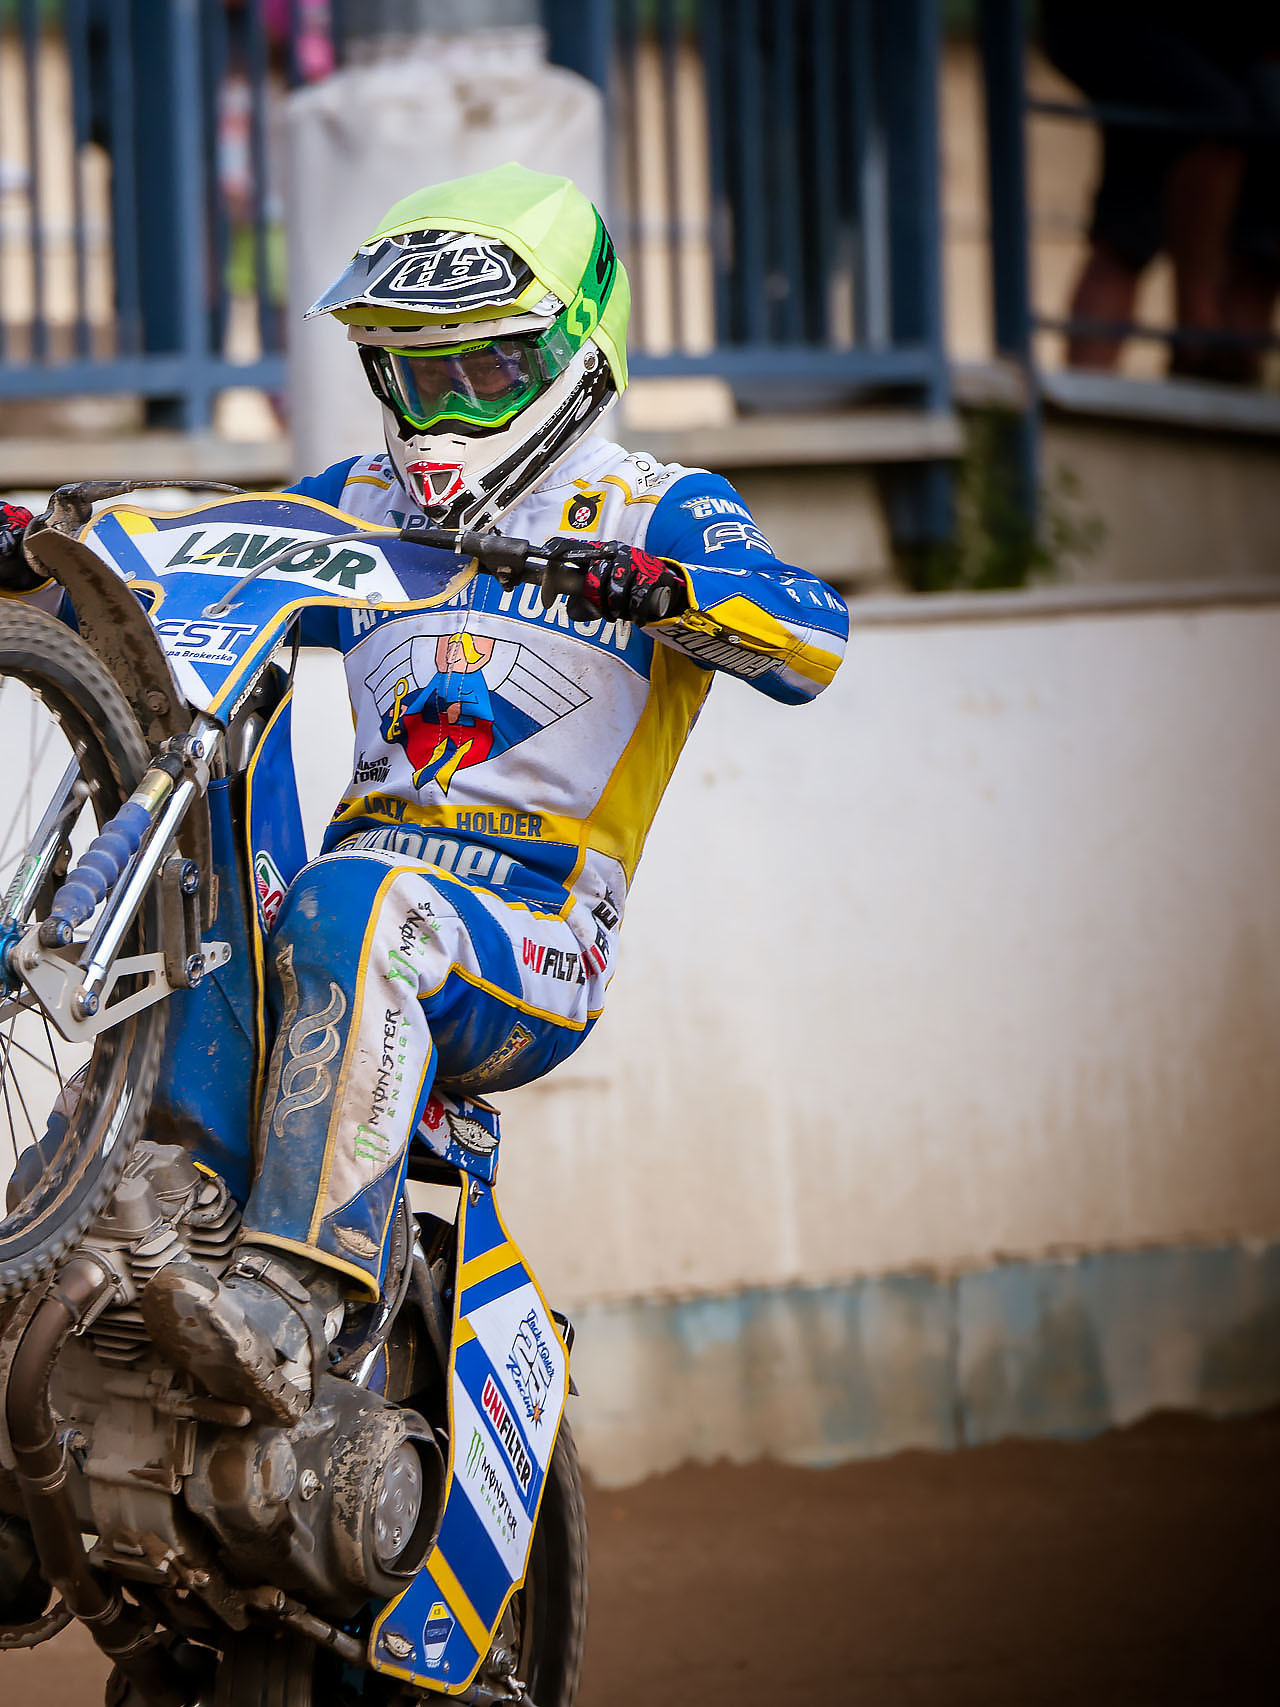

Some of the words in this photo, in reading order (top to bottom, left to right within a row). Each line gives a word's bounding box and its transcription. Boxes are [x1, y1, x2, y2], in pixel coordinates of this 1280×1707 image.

[165, 531, 377, 590] LAVOR
[182, 650, 233, 662] Brokerska
[456, 812, 544, 838] HOLDER
[386, 1017, 412, 1119] ENERGY
[505, 1353, 535, 1418] Racing
[482, 1379, 532, 1491] UNIFILTER
